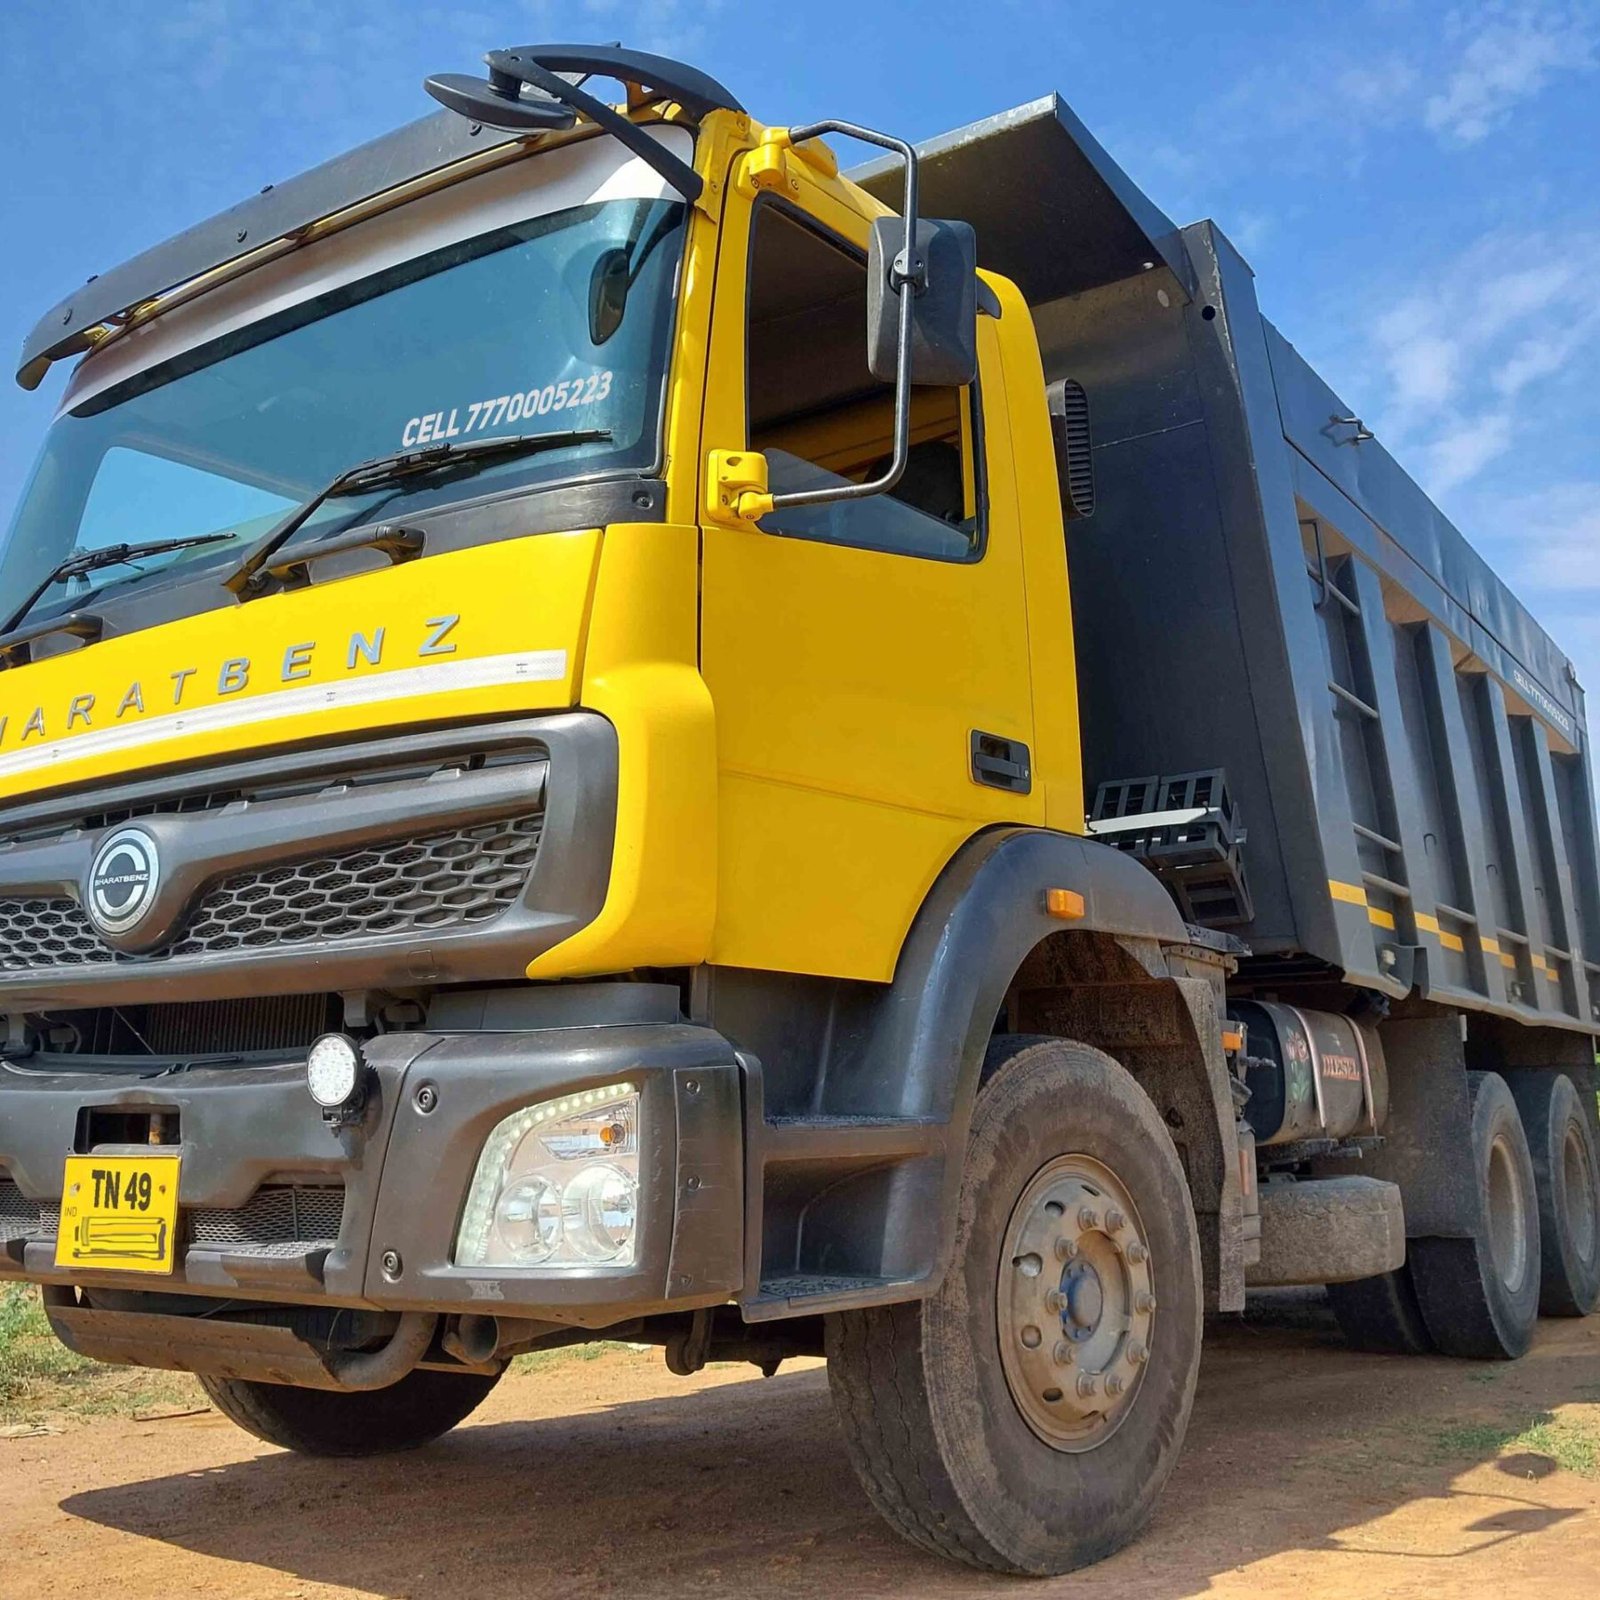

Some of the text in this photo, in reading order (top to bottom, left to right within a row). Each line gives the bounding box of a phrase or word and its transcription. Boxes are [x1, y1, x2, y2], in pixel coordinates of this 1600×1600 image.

[402, 370, 613, 447] CELL 7770005223
[0, 614, 460, 746] ARATBENZ
[91, 1169, 152, 1211] TN 49
